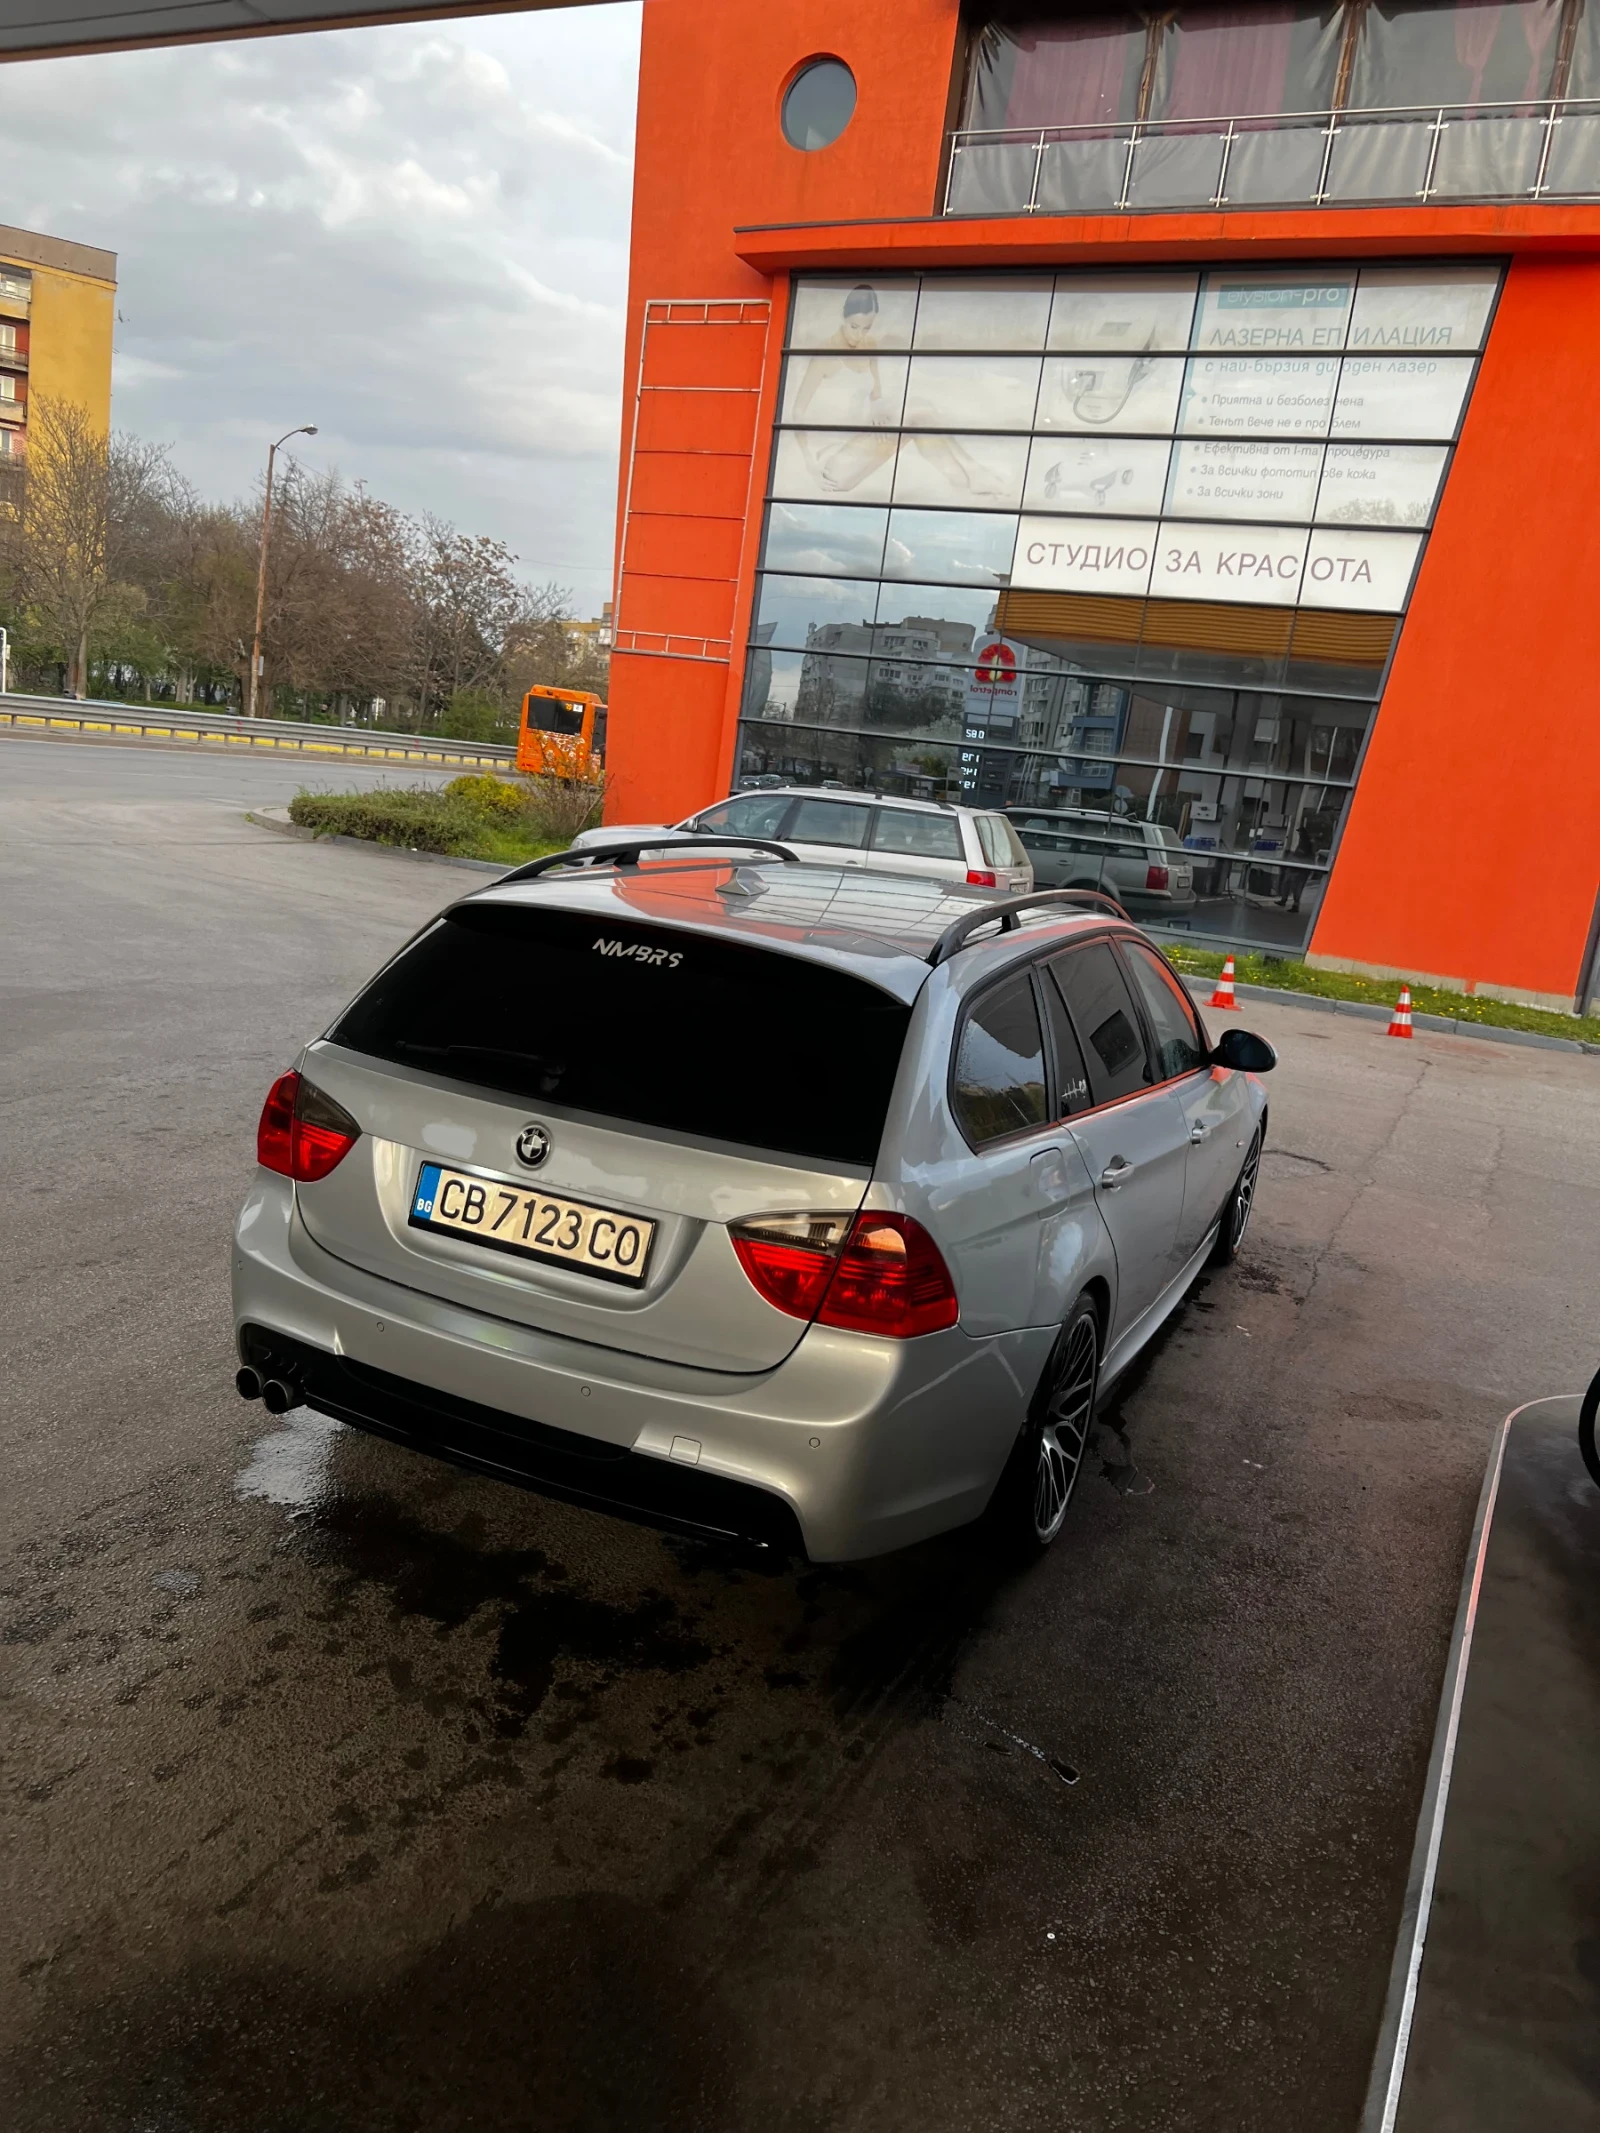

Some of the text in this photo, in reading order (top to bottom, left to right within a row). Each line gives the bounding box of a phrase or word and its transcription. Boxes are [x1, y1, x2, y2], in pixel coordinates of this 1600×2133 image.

[1227, 286, 1340, 306] elysion-pro
[1209, 327, 1304, 347] ЛАЗЕРНА
[1205, 363, 1213, 372] с
[1219, 359, 1310, 375] най-бързия
[1387, 361, 1437, 375] лазер
[1212, 394, 1262, 406] Приятна
[1266, 397, 1273, 405] и
[1247, 416, 1275, 428] вече
[1277, 418, 1293, 428] не
[1294, 419, 1302, 428] е
[1305, 417, 1361, 430] проблем
[1203, 443, 1269, 455] Ефективна
[1273, 447, 1290, 455] от
[1327, 446, 1390, 459] процедура
[1200, 465, 1214, 475] За
[1218, 465, 1257, 477] всички
[1346, 468, 1377, 480] кожа
[1197, 486, 1284, 499] За всички зони
[1026, 542, 1373, 583] СТУДИО ЗА КРАСОТА
[592, 938, 684, 968] NMBRS
[416, 1197, 433, 1213] BG
[491, 1192, 583, 1251] 7123
